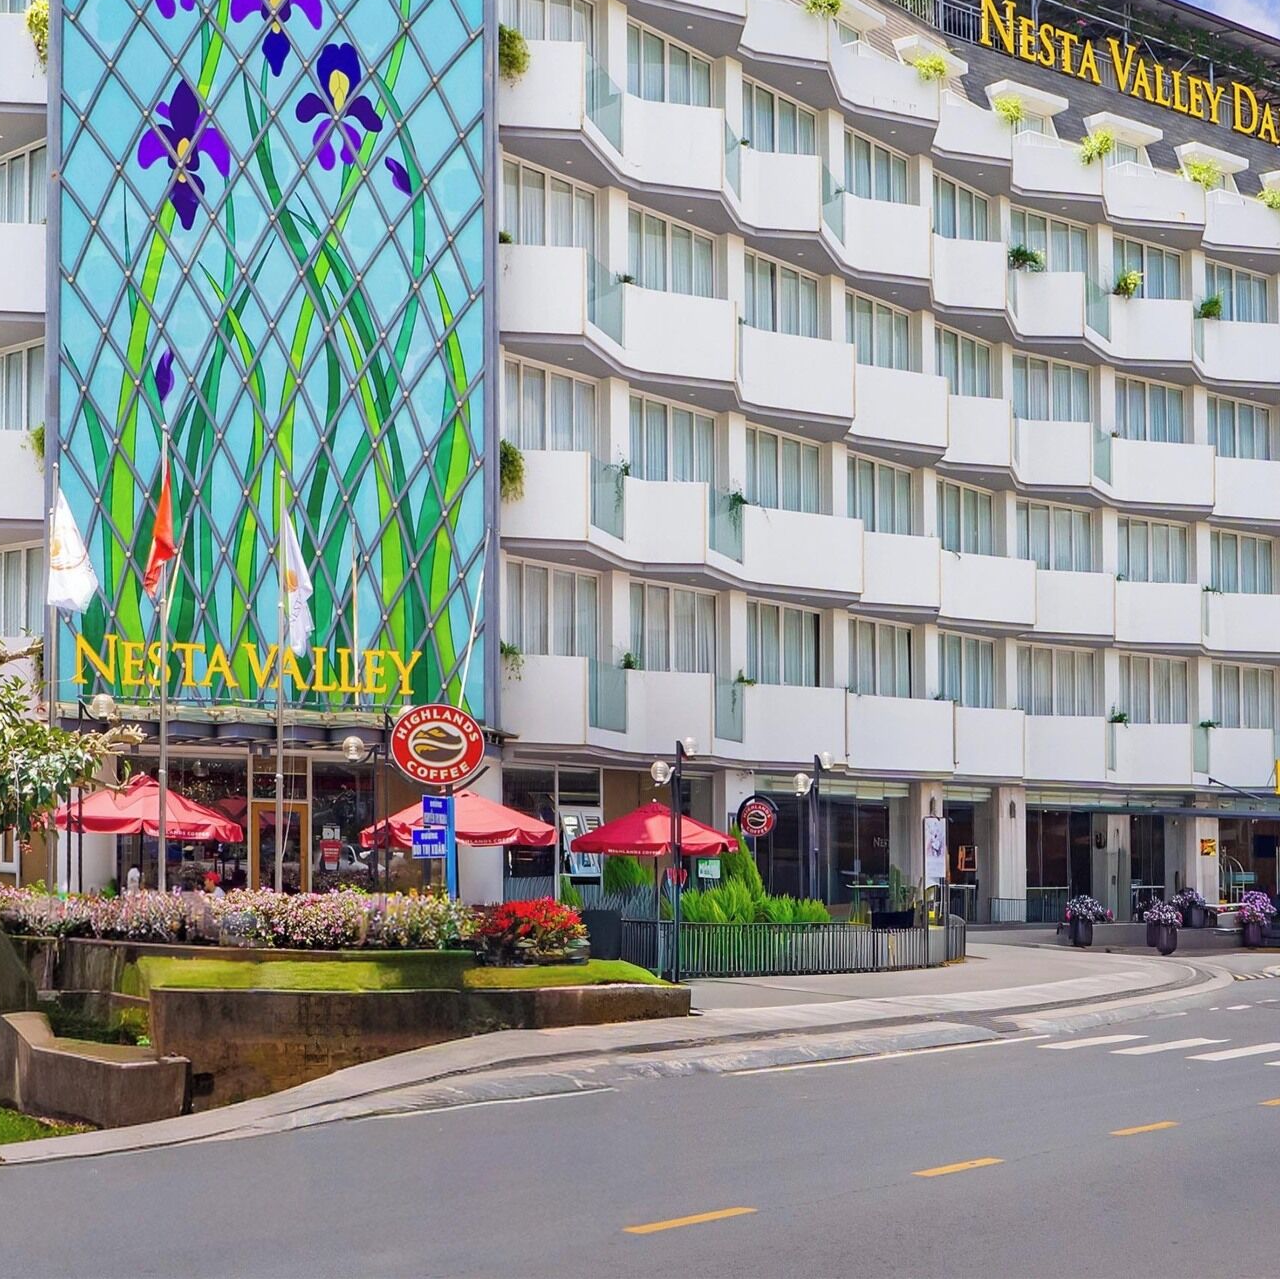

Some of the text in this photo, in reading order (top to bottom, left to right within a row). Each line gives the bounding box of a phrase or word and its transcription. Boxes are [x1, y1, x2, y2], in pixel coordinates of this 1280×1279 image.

[1106, 36, 1224, 125] VALLEY
[73, 633, 422, 696] NESTA VALLEY
[396, 708, 480, 780] HIGHLANDS COFFEE
[746, 825, 768, 835] COFFEE
